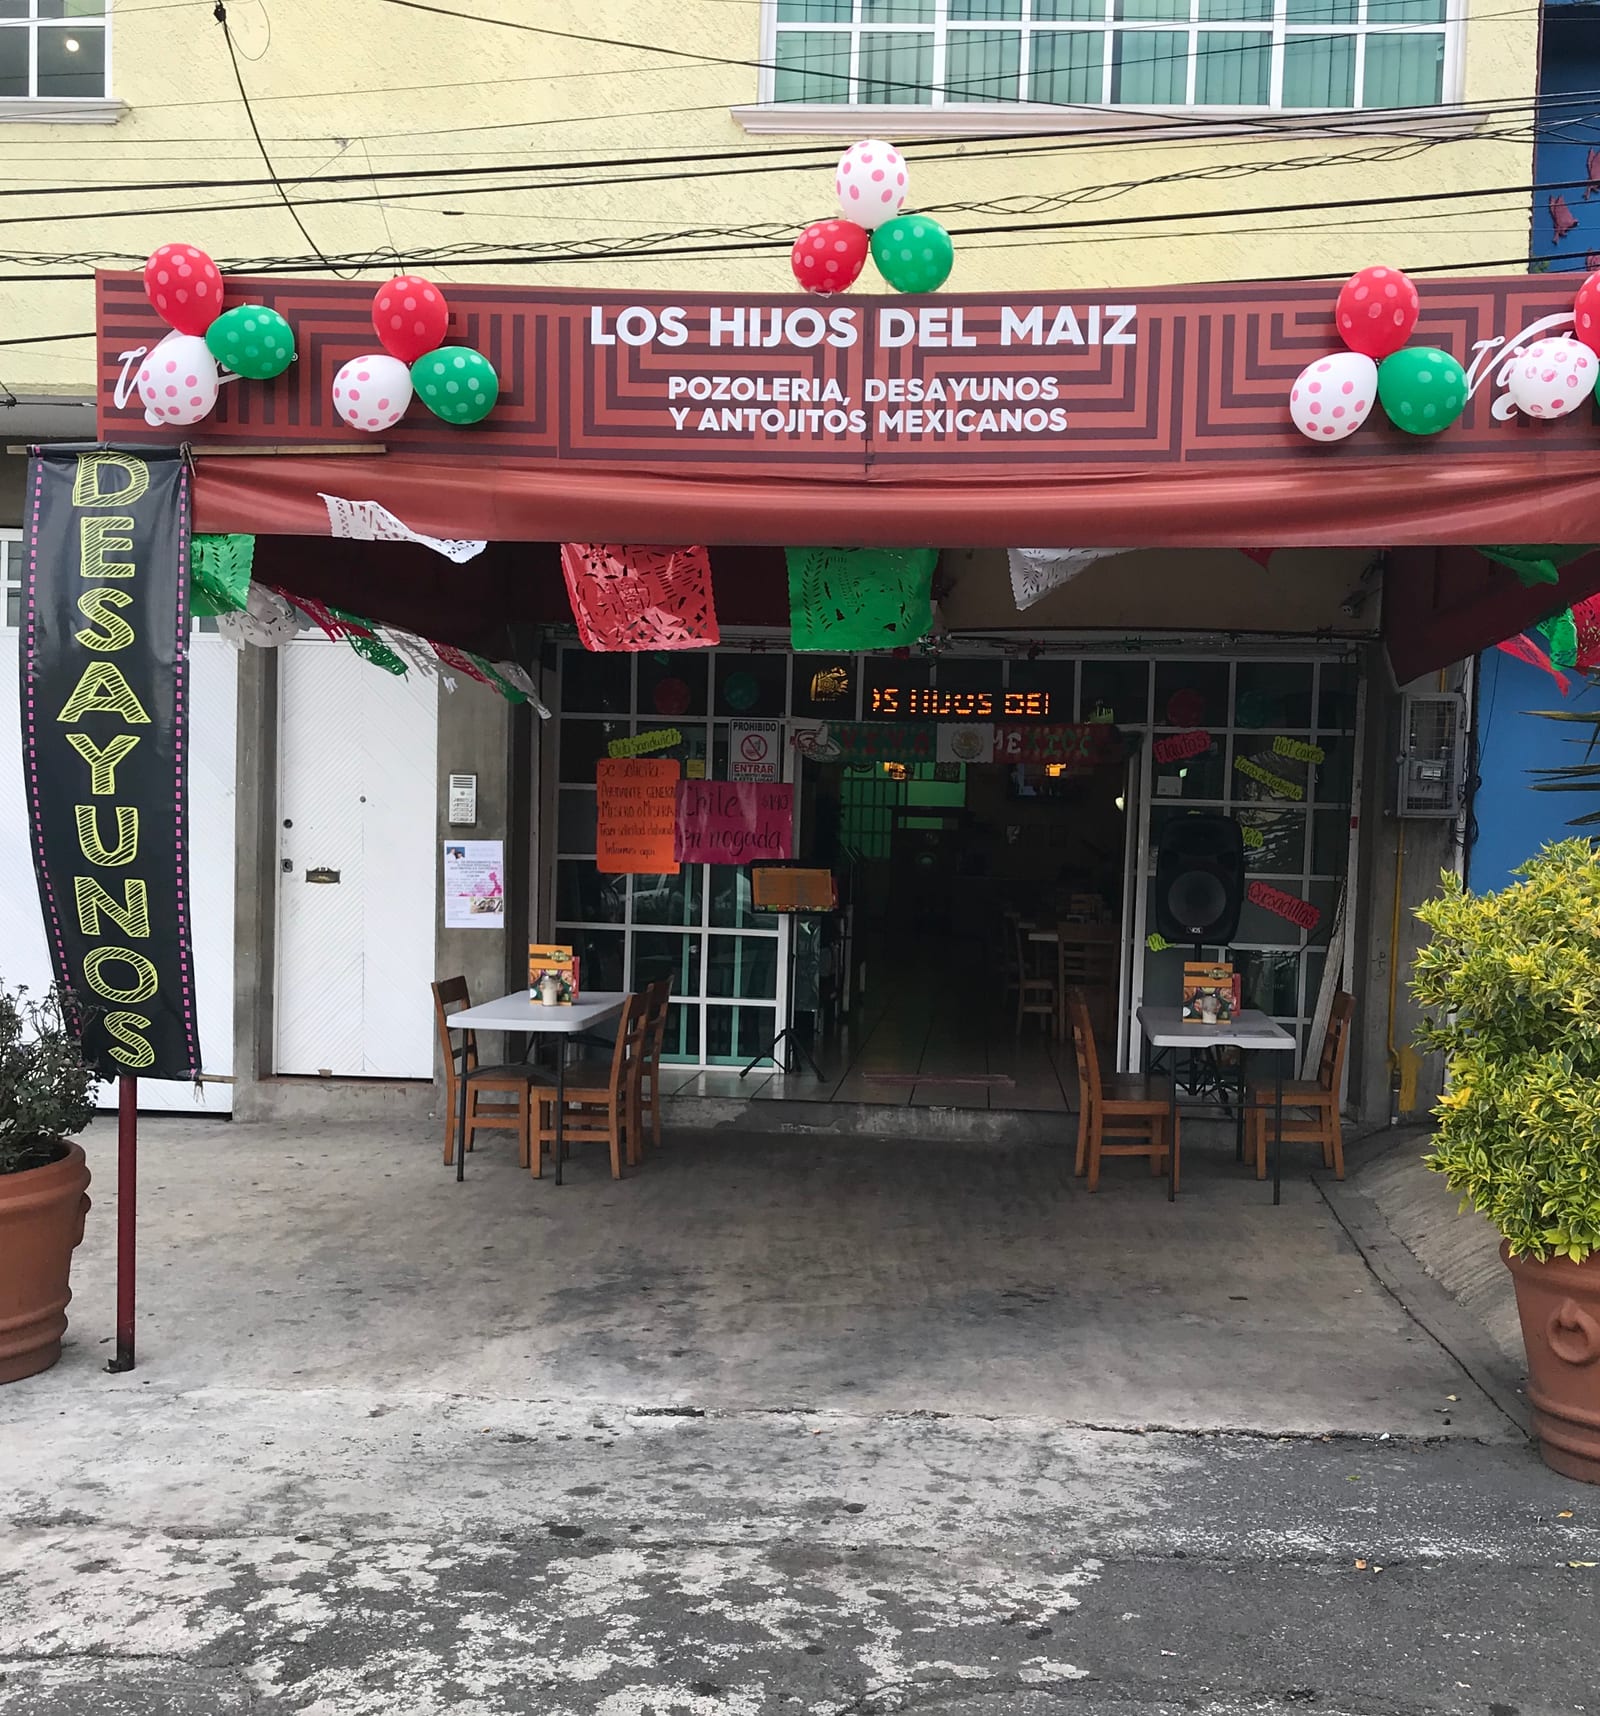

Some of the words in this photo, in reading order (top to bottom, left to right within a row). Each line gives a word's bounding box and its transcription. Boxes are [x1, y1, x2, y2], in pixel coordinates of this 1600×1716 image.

[591, 306, 688, 346] LOS
[710, 308, 857, 347] HIJOS
[880, 308, 976, 347] DEL
[1001, 305, 1136, 345] MAIZ
[668, 376, 851, 406] POZOLERIA,
[865, 377, 1058, 402] DESAYUNOS
[669, 408, 690, 430] Y
[698, 408, 866, 433] ANTOJITOS
[879, 408, 1067, 433] MEXICANOS
[733, 721, 777, 732] PROHIBIDO
[841, 728, 931, 756] VIVA
[1156, 735, 1208, 760] Flautas
[1275, 738, 1294, 755] Hot
[57, 452, 157, 1067] DESAYUNOS
[734, 764, 774, 774] ENTRAR
[679, 829, 702, 849] en
[709, 821, 782, 857] nogada
[1250, 882, 1315, 926] Quesadillas
